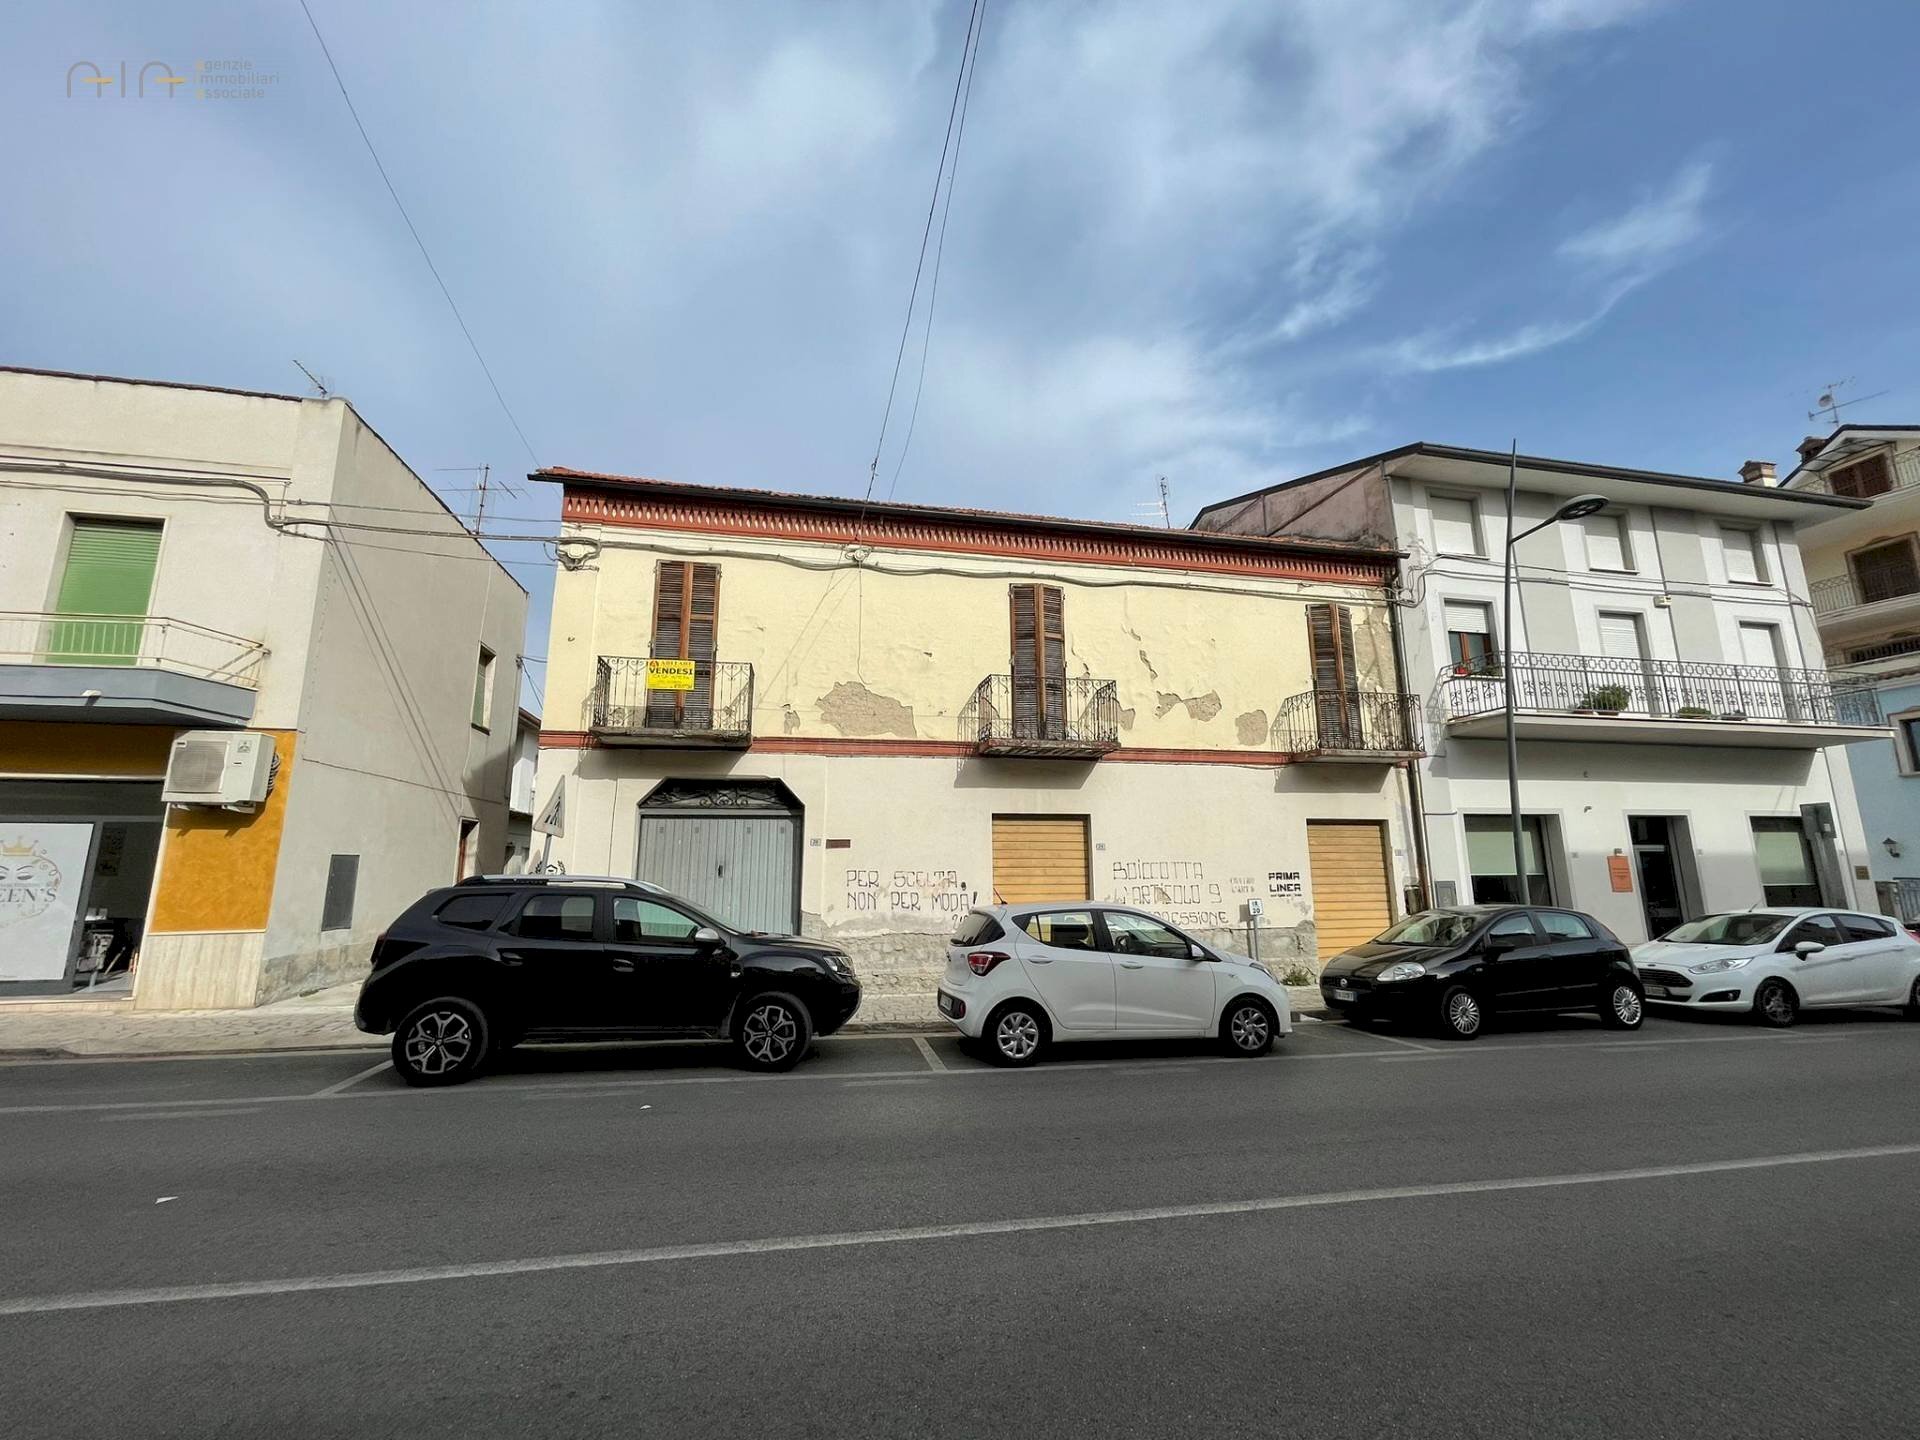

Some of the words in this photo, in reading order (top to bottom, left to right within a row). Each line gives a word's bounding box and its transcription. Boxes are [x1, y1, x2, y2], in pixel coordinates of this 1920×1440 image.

[649, 667, 692, 675] VENDESI
[846, 870, 879, 888] PER
[1268, 872, 1300, 881] PRIMA
[1208, 883, 1223, 904] 9
[1269, 883, 1302, 893] LINEA
[847, 891, 878, 911] NON
[890, 891, 921, 911] PER
[931, 891, 978, 911] MODA!
